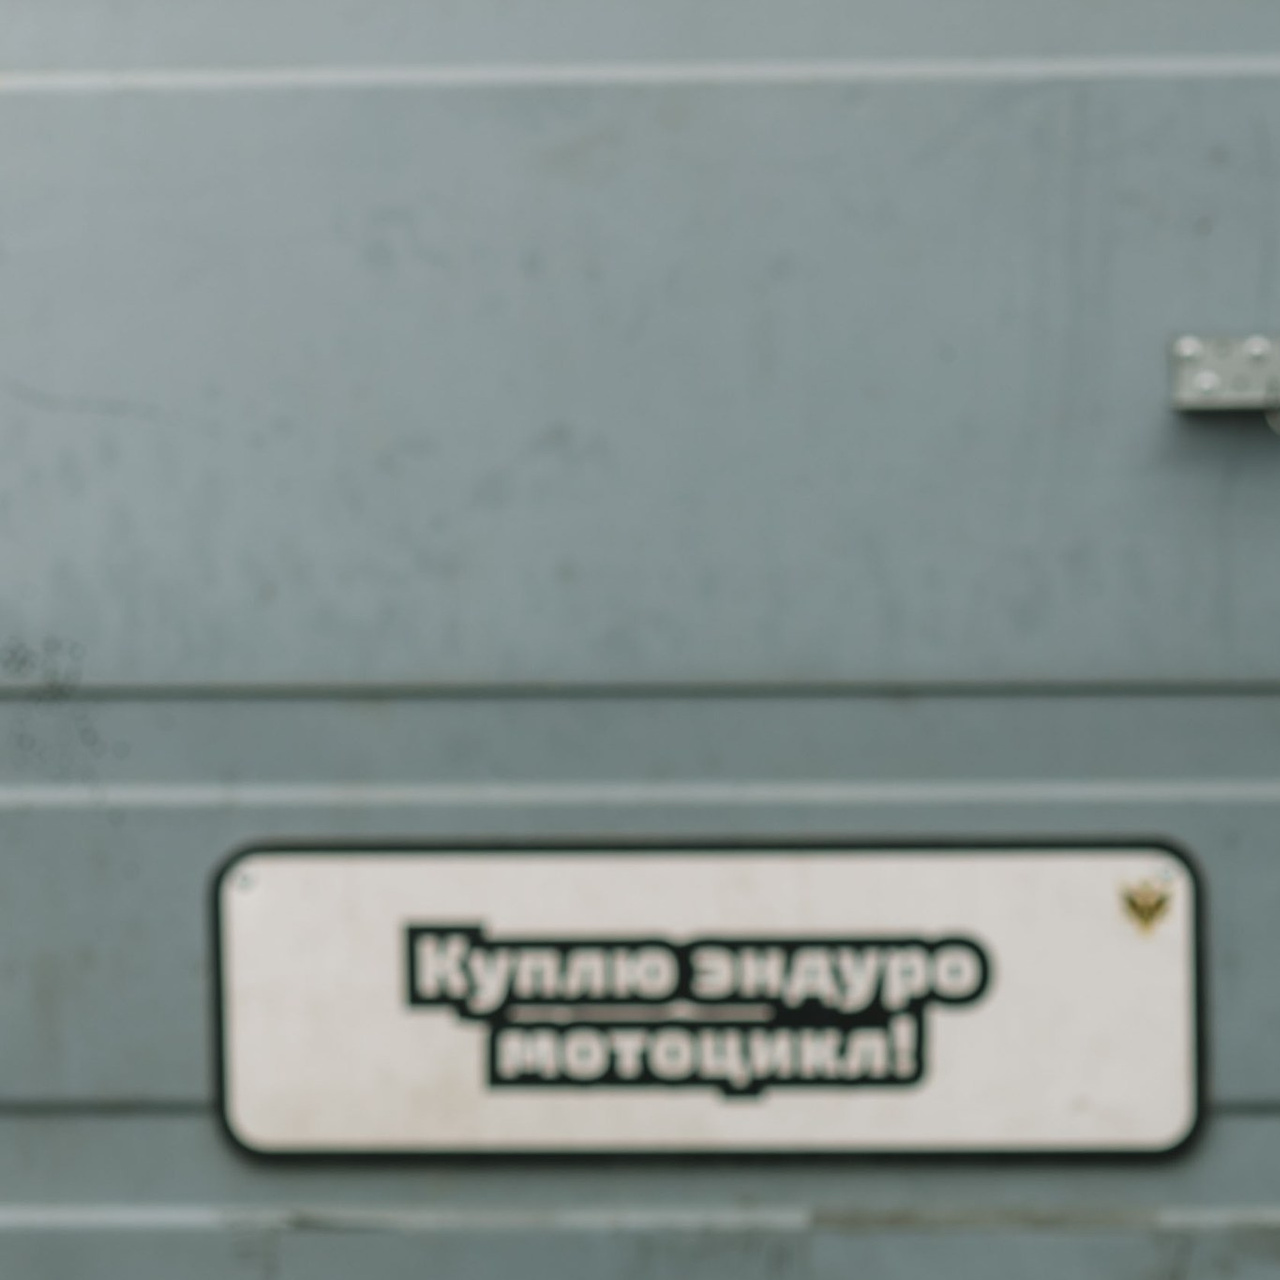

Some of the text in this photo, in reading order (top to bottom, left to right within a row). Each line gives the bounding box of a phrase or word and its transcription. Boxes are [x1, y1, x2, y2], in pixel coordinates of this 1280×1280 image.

[413, 931, 983, 1015] Куплю эндуро
[495, 1013, 918, 1089] мотоцикл!
